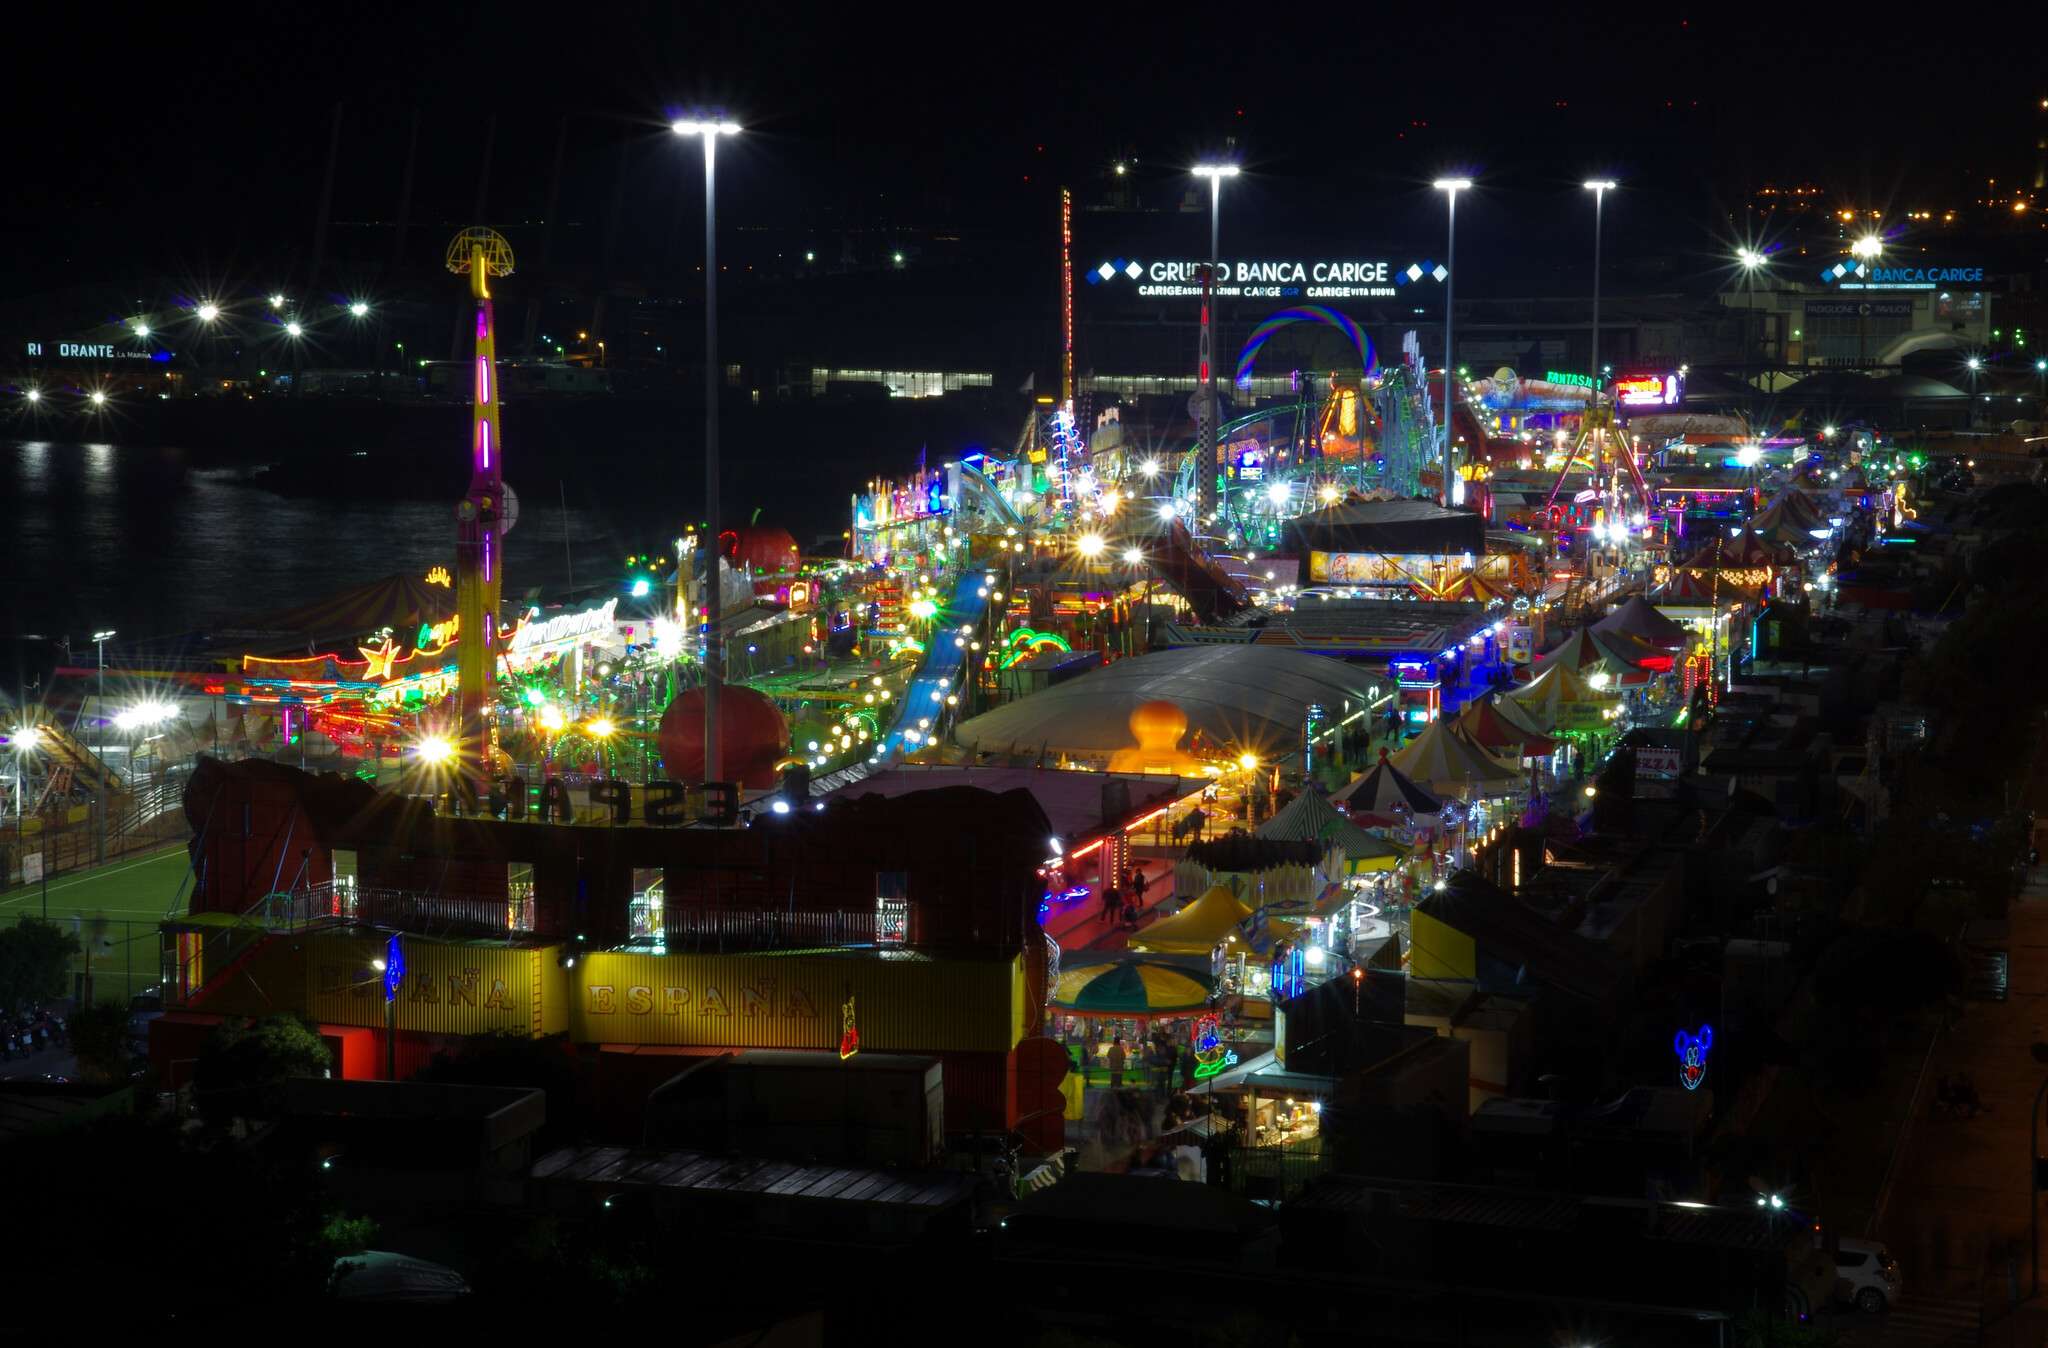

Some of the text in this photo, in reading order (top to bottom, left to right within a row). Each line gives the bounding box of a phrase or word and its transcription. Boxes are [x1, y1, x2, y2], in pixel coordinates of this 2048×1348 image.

[1149, 262, 1388, 282] GRUO BANCA CARIGE
[1872, 267, 1984, 281] BANCA CARIGE
[1138, 285, 1182, 296] CARIGE
[1244, 287, 1281, 297] CARIGE
[1306, 286, 1350, 297] CARIGE
[27, 342, 114, 358] RIORANTE
[588, 976, 816, 1017] ESPAÑA
